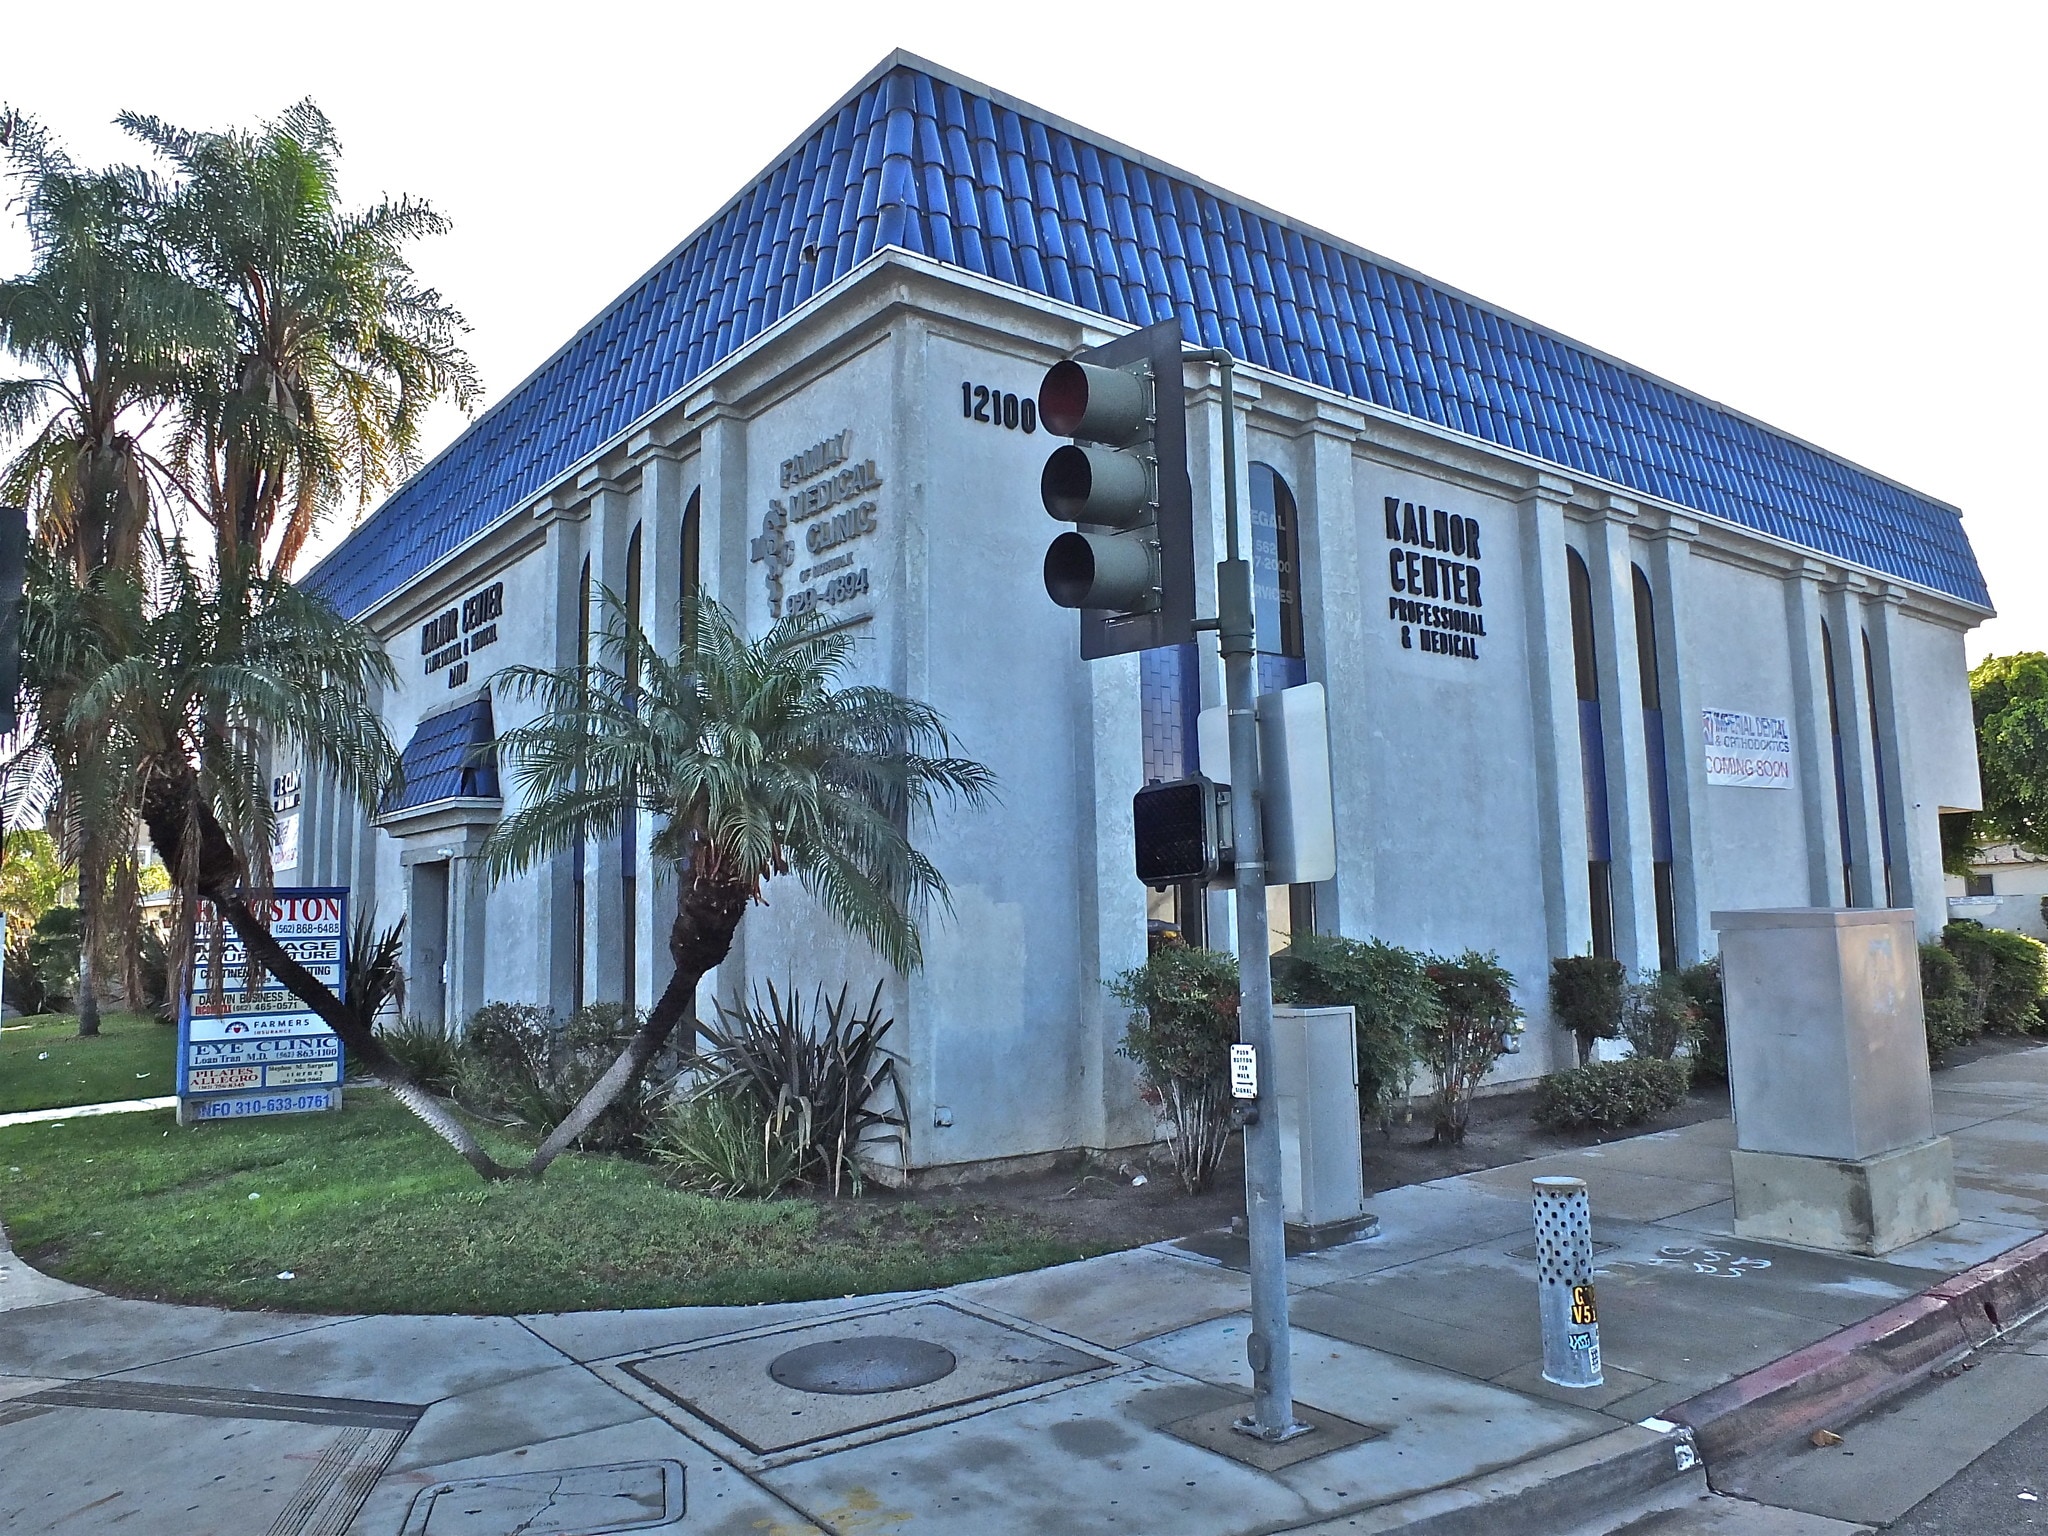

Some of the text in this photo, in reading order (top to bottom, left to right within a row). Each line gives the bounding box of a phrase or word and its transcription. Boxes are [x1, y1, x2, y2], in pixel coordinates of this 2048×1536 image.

[962, 381, 1036, 434] 12100
[780, 428, 852, 488] FAMILY
[789, 459, 883, 523] MEDICAL
[806, 501, 877, 554] CLINIC
[1250, 509, 1286, 531] EGAL
[1389, 548, 1482, 607] CENTER
[786, 568, 869, 617] 929-4894
[1389, 597, 1486, 636] PROFESSIONAL
[1401, 625, 1479, 660] & MEDICAL
[1706, 755, 1788, 778] COMING SOON
[240, 992, 283, 1004] BSINESS
[255, 1002, 297, 1011] 465-0571
[254, 1019, 309, 1028] FARMERS
[196, 1037, 338, 1055] EYE CLINIC
[190, 1074, 258, 1085] ALLEGRO
[196, 1067, 253, 1078] PILATES
